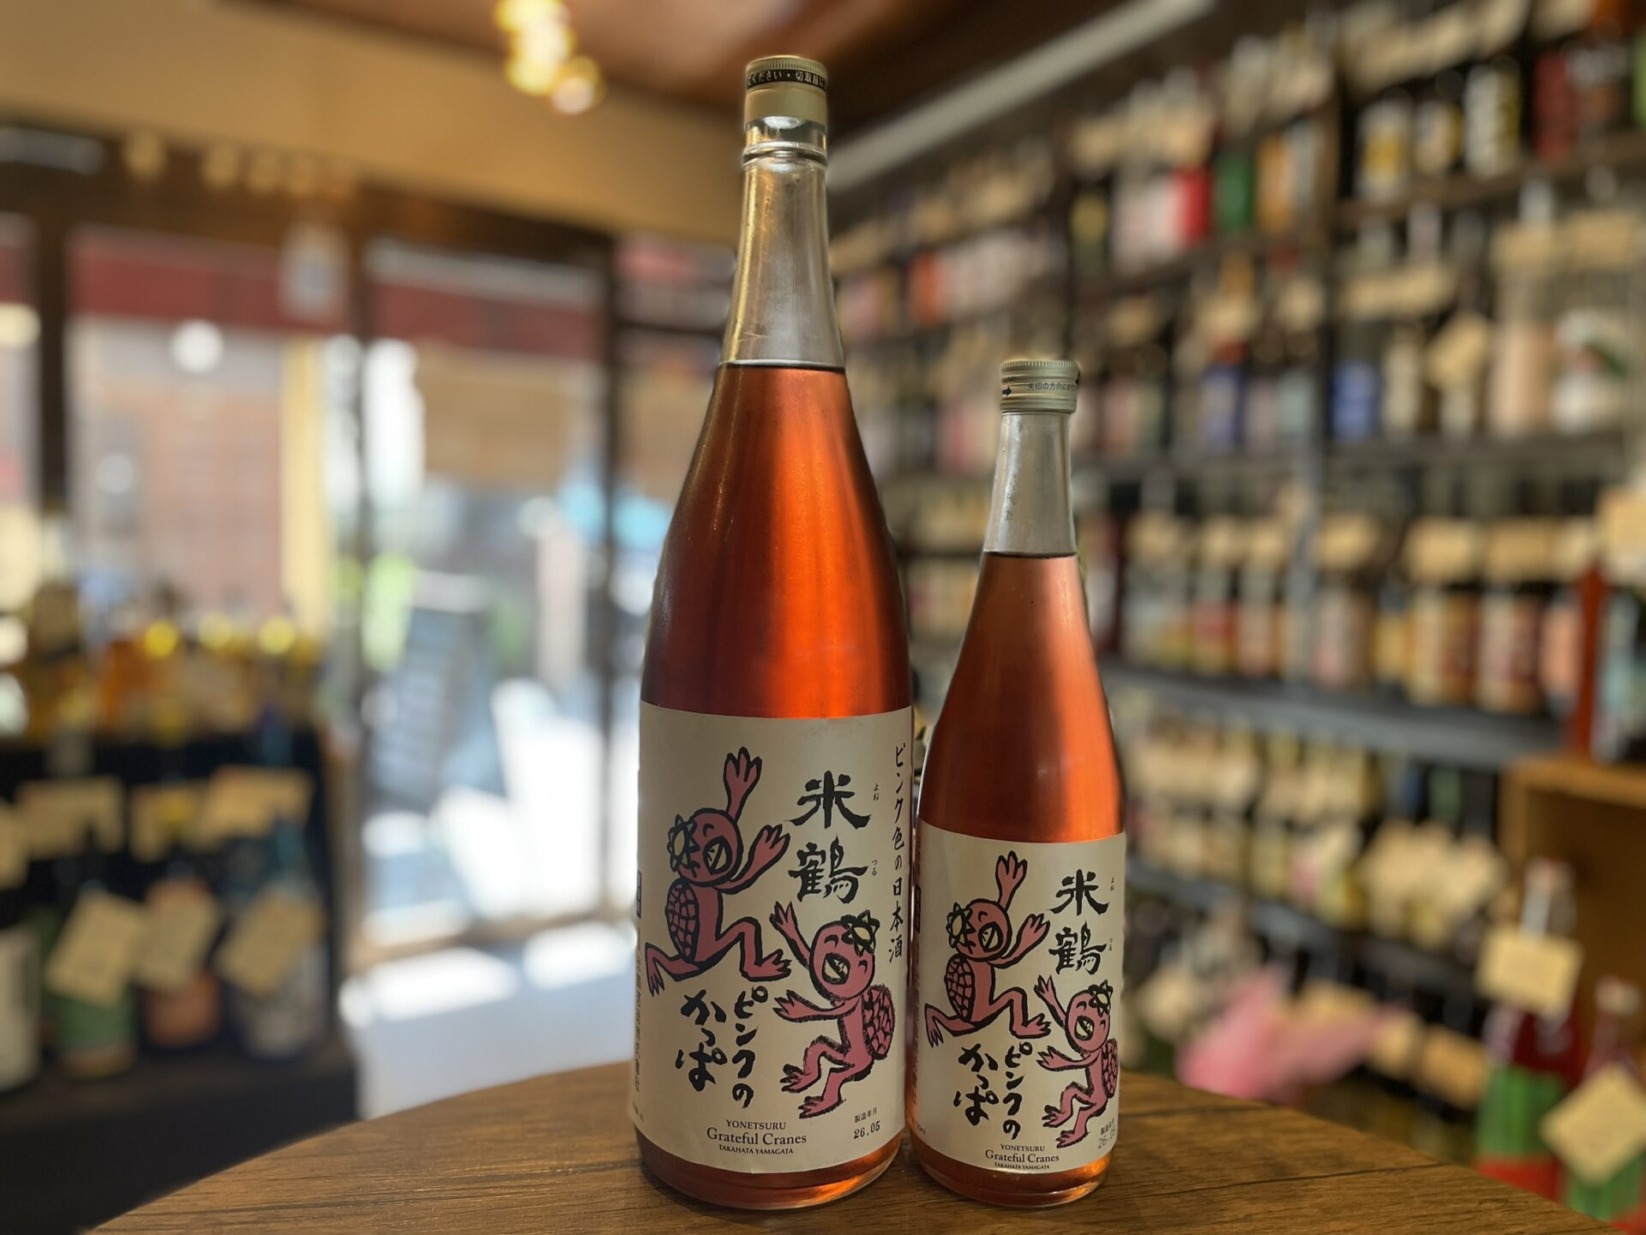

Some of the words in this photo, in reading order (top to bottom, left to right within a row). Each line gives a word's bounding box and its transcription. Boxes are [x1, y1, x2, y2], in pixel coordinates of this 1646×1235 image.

[784, 770, 872, 904] 米鶴
[1048, 869, 1109, 975] 米鶴
[675, 989, 727, 1092] かっぱ
[953, 1043, 999, 1126] かっぱ
[726, 1119, 786, 1131] YONETSURU
[853, 1120, 881, 1139] 26.05
[706, 1127, 759, 1146] Grateful
[762, 1132, 807, 1146] Cranes
[718, 1144, 754, 1155] TAKAHATA
[755, 1147, 794, 1156] YAMAGATA
[985, 1149, 1025, 1163] Grateful
[1027, 1153, 1060, 1163] Cranes
[1000, 1143, 1046, 1152] YONETSURU
